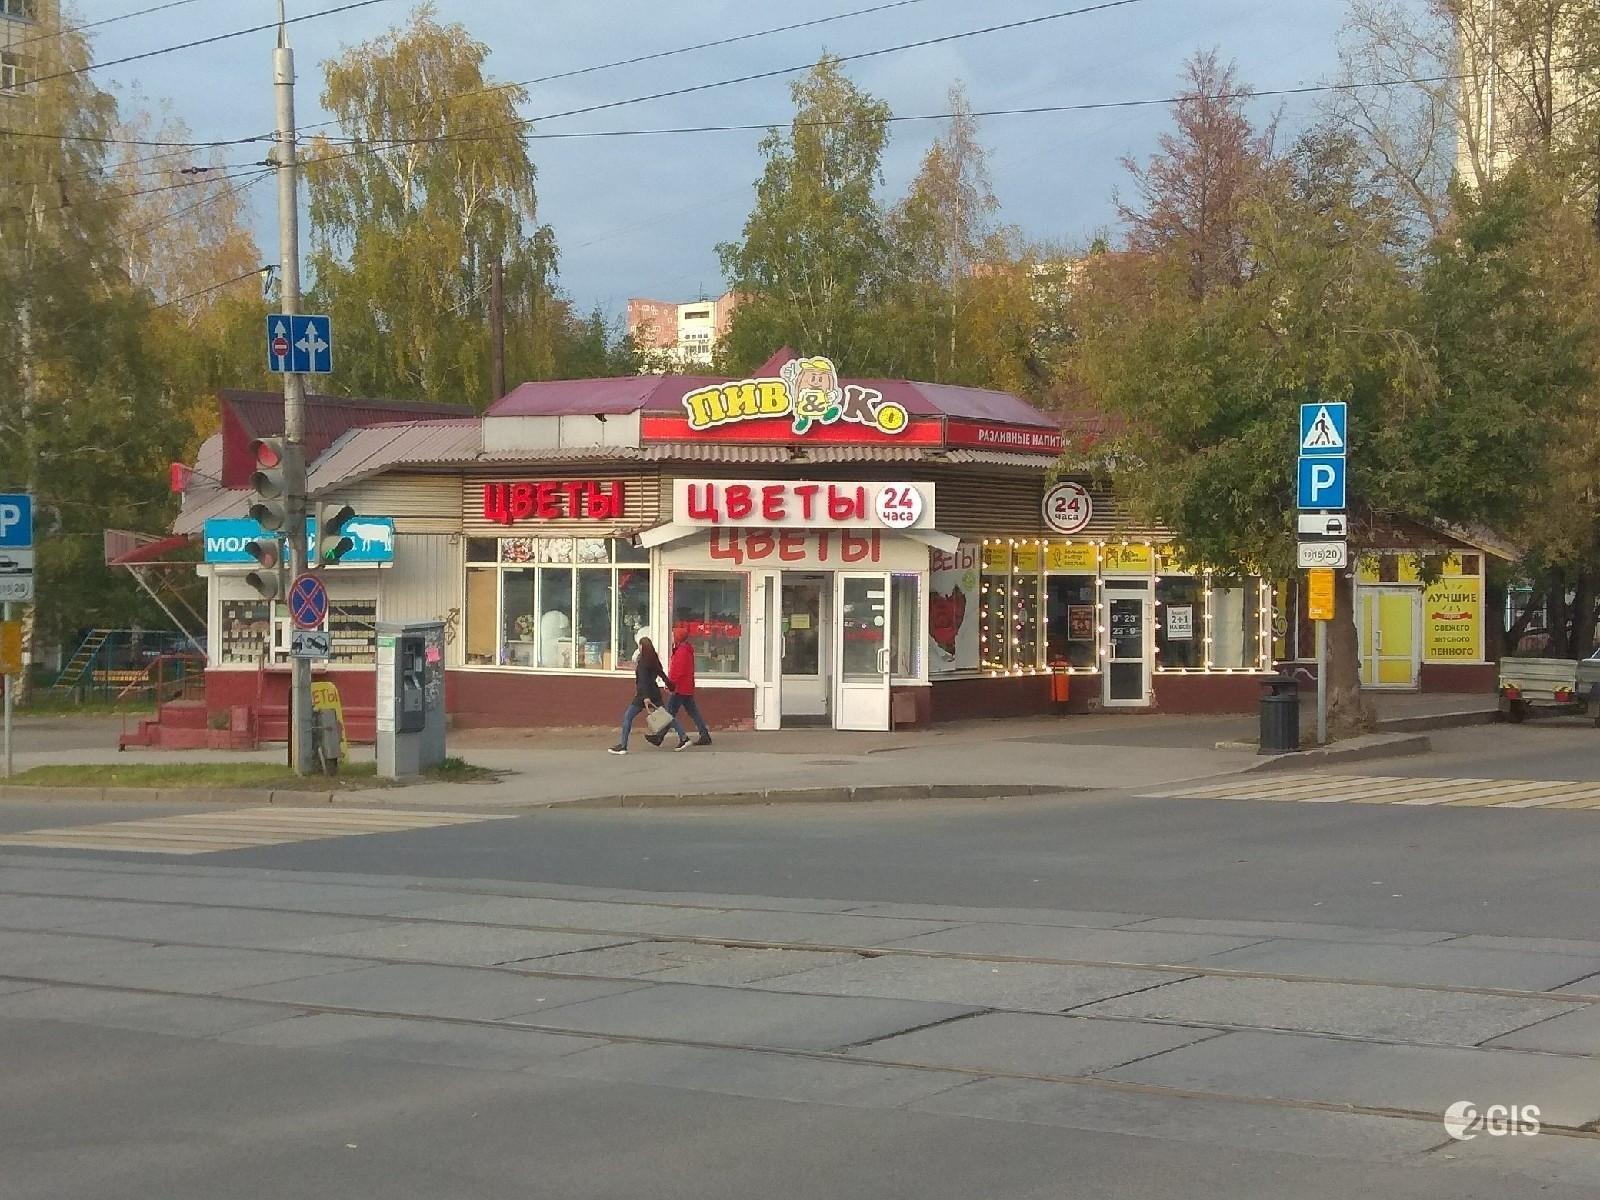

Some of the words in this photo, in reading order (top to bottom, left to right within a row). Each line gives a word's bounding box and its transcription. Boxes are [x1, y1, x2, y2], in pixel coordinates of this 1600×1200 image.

[686, 381, 790, 427] ПИВ
[978, 428, 1031, 446] РАЗЛИВНЫЕ
[1311, 464, 1336, 502] P
[483, 481, 625, 526] ЦВЕТЫ
[687, 483, 866, 523] ЦВЕТЫ
[883, 488, 914, 509] 24
[1054, 497, 1080, 513] 24
[882, 511, 914, 522] часа
[1054, 513, 1079, 521] часа
[708, 527, 881, 565] ЦВЕТЫ
[1325, 549, 1338, 559] 20
[1427, 593, 1477, 603] ЛУЧШИЕ
[1434, 624, 1470, 632] СВЕЖЕГО
[1430, 647, 1474, 656] ПЕННОГО
